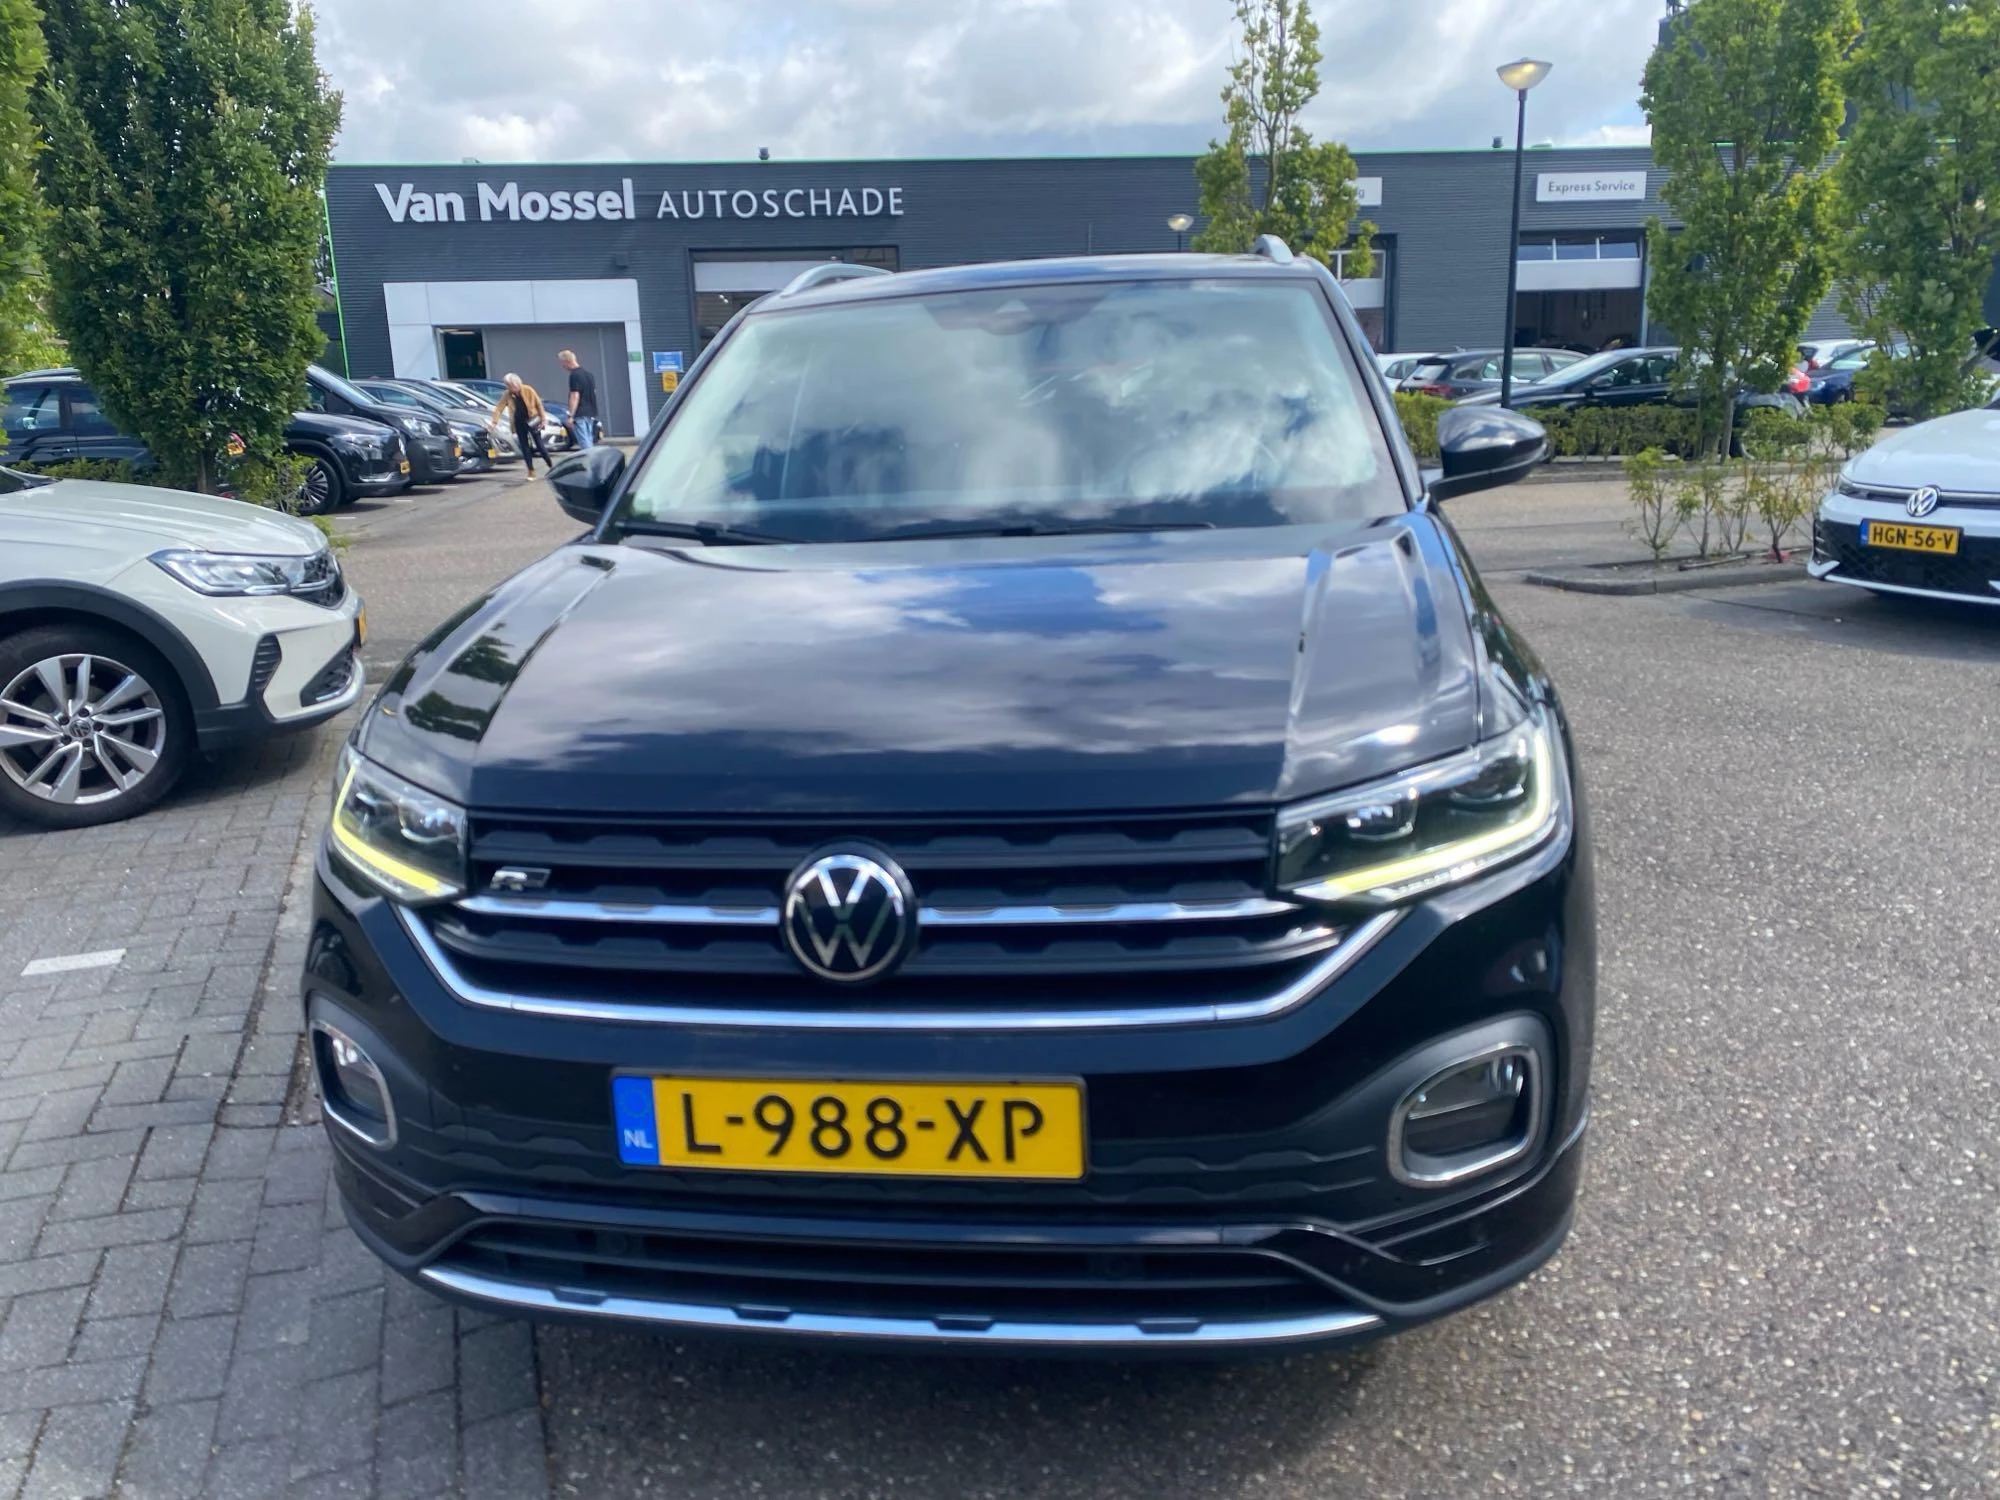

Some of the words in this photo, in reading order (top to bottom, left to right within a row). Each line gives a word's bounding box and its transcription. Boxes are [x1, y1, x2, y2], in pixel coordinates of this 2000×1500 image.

[1548, 181, 1592, 195] Express
[1594, 180, 1635, 192] Service
[374, 182, 466, 223] Van
[476, 178, 636, 222] Mossel
[656, 187, 905, 219] AUTOSCHADE
[1872, 525, 1954, 550] HGN-56-V
[623, 1129, 654, 1150] NL
[681, 1092, 1044, 1162] L-988-XP
